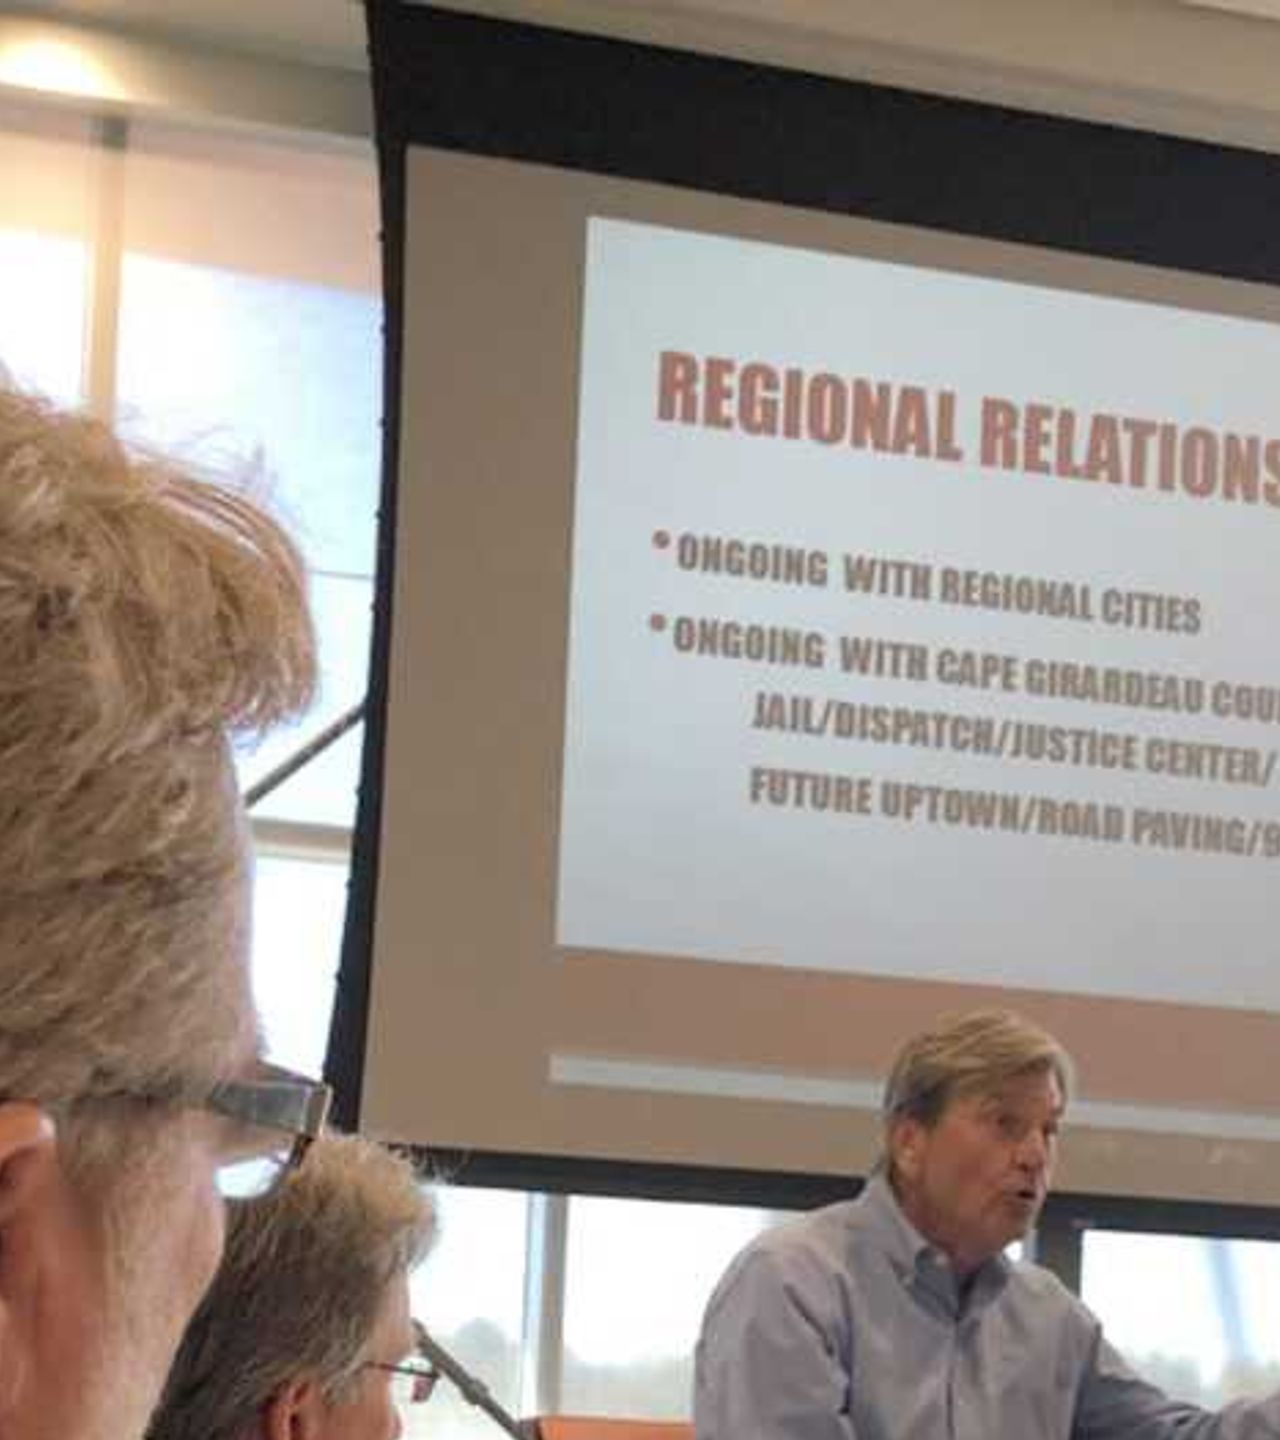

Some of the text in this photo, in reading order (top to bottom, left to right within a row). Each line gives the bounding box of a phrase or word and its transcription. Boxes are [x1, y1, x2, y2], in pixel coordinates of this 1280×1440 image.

[657, 350, 963, 462] REGIONAL
[677, 532, 1202, 634] ONGOING WITH REGIONAL CITIES
[673, 616, 825, 669] ONGOING
[839, 636, 929, 681] WITH
[936, 649, 1018, 691] CAPE
[1024, 658, 1205, 715] GIRARDEAU
[751, 691, 1279, 787] JAIL/DISPATCH/JUSTICE CENTER/
[749, 767, 872, 815] FUTURE
[881, 784, 1125, 842] UPTOWN/ROAD
